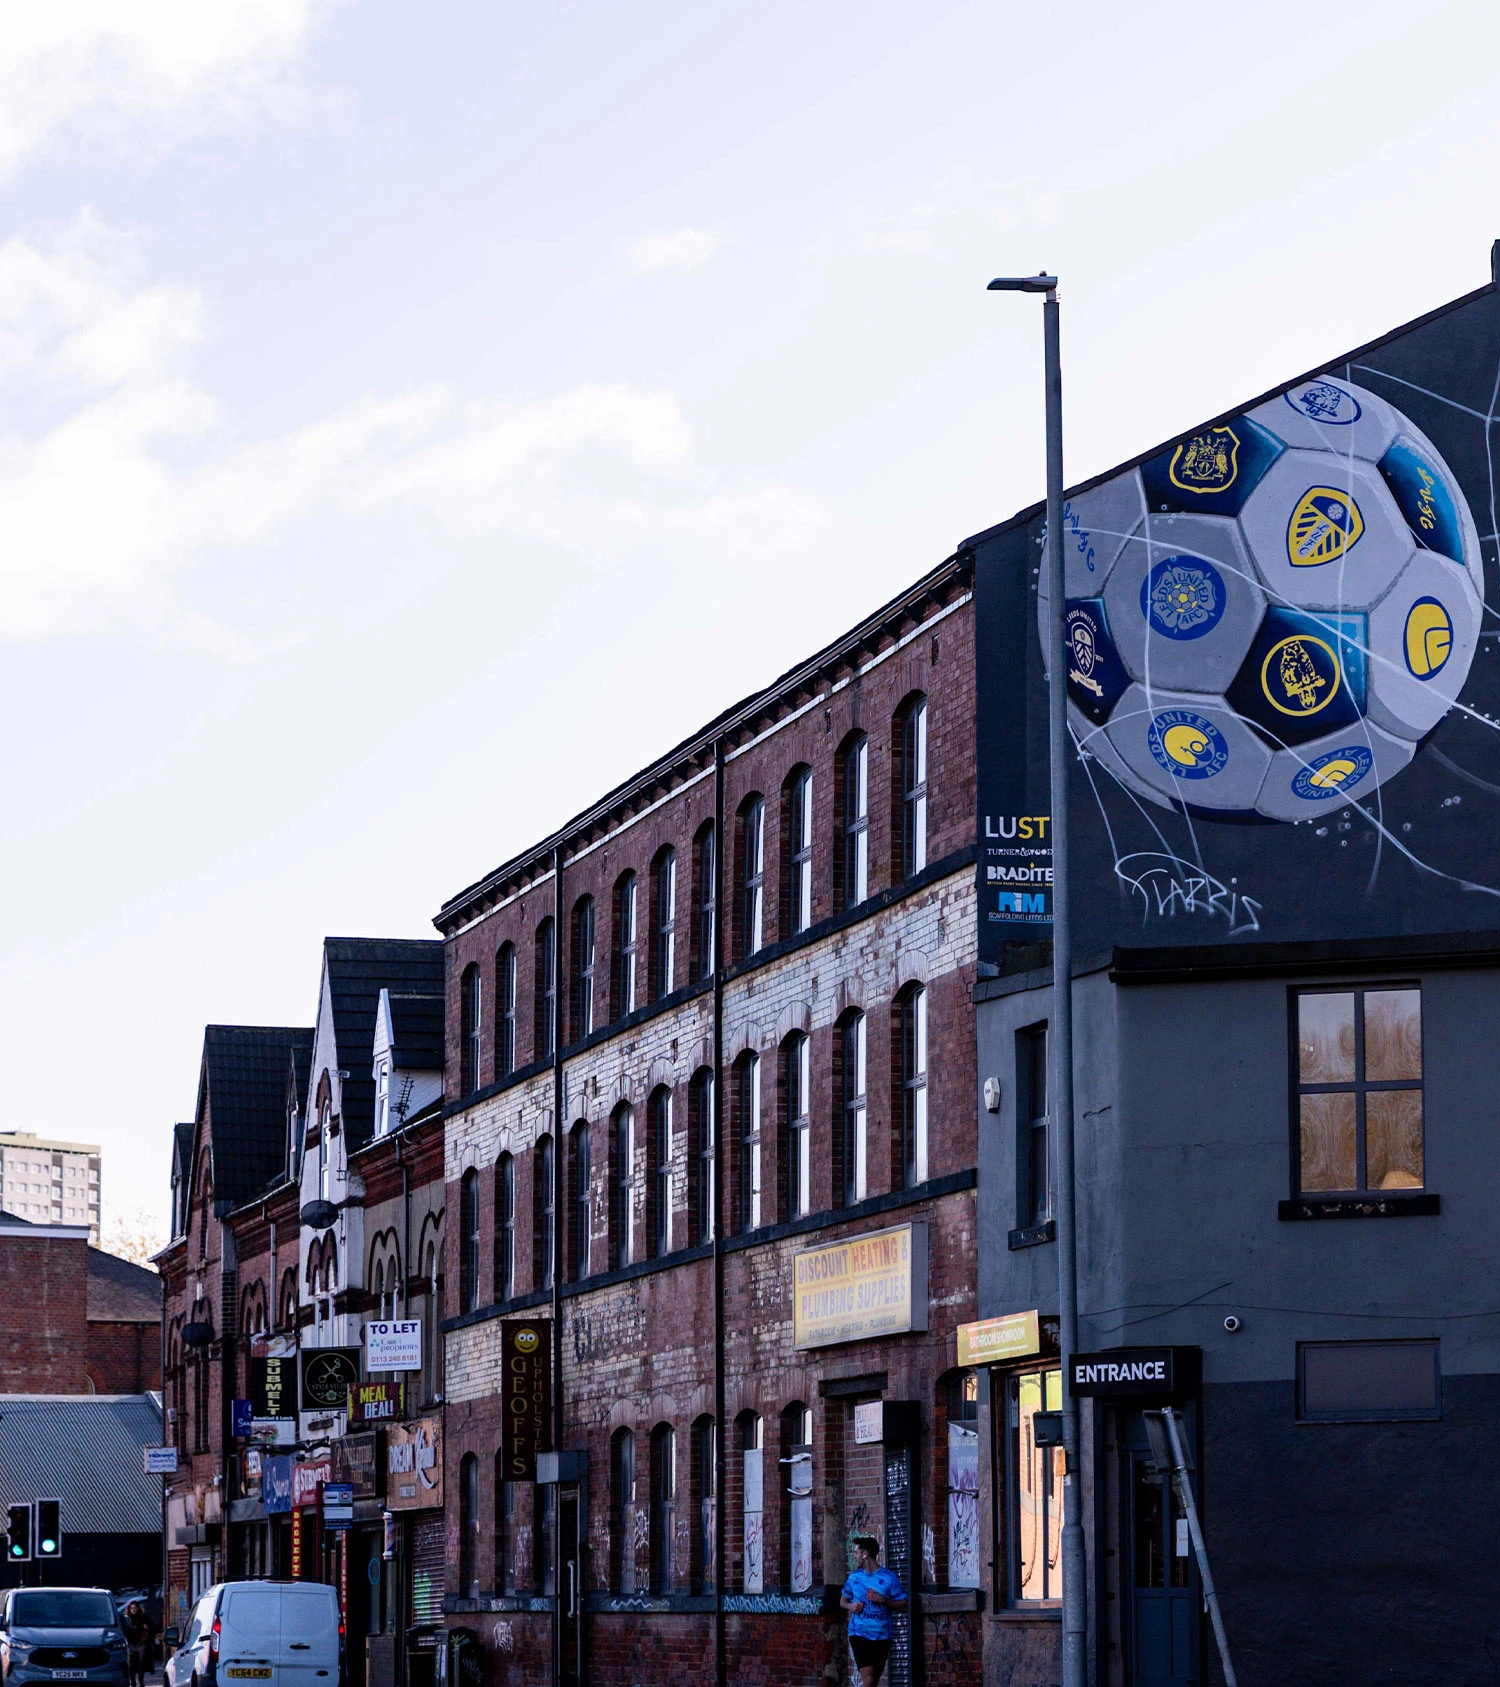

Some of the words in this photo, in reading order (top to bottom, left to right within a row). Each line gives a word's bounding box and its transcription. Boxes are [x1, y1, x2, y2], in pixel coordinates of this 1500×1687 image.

[1158, 579, 1174, 618] LEEDS
[1178, 573, 1209, 603] UNITED
[1181, 609, 1203, 624] AFC
[1155, 711, 1218, 736] UNITED
[1149, 734, 1187, 777] LEEDS
[1206, 752, 1227, 776] AFC
[985, 816, 1050, 839] LUST
[989, 912, 1025, 920] SCAFFOLDING
[798, 1249, 848, 1284] DISCOUNT
[852, 1237, 898, 1272] HEATING
[902, 1235, 908, 1261] &
[802, 1286, 854, 1319] PLUMBING
[858, 1274, 906, 1309] SUPPLIES
[370, 1324, 388, 1334] TO
[393, 1323, 418, 1334] LET
[969, 1332, 996, 1349] BATHROOM
[997, 1326, 1025, 1344] SHOWROOM
[1074, 1361, 1166, 1383] ENTRANCE
[265, 1358, 282, 1415] SUBMELT
[360, 1384, 387, 1404] MEAL
[364, 1399, 394, 1420] DEAL!
[510, 1356, 528, 1475] GEOFFS
[532, 1356, 543, 1463] UPHOLSTE
